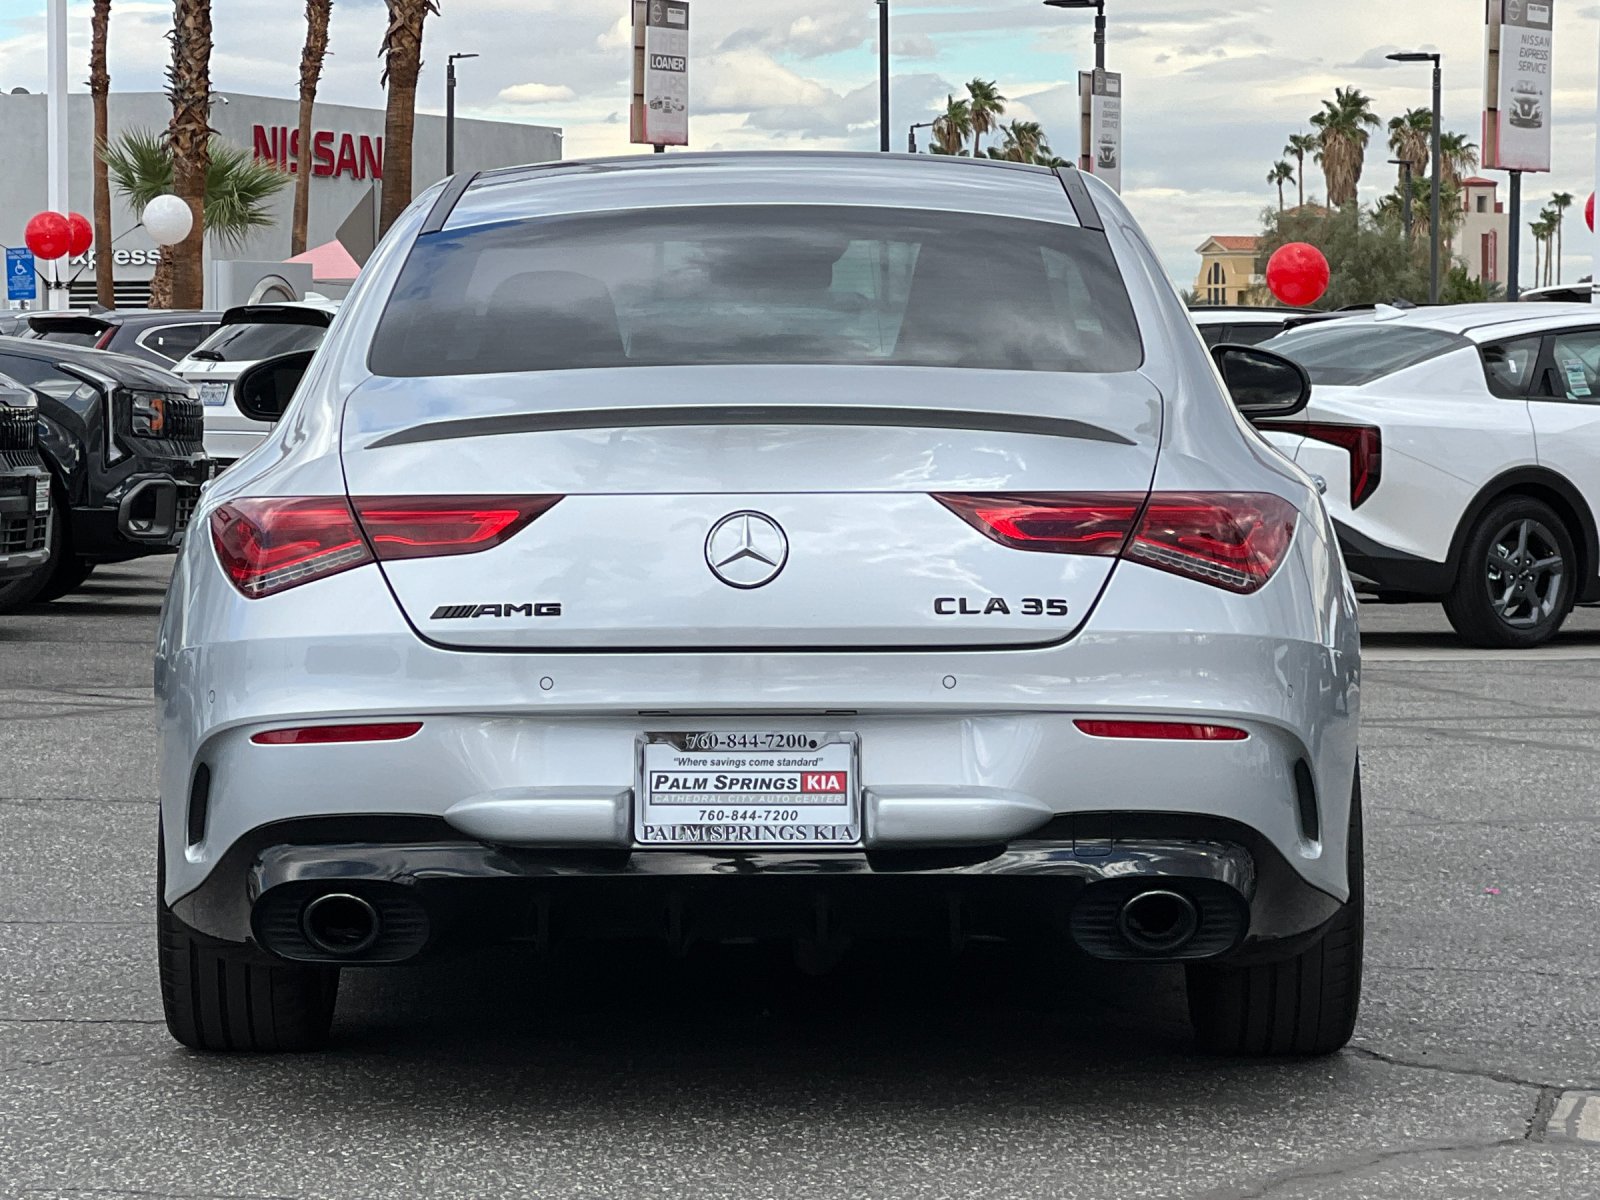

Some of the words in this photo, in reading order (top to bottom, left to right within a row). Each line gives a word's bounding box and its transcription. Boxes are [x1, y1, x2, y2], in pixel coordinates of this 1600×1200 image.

[1521, 34, 1551, 47] NISSAN
[1519, 47, 1549, 60] EXPRESS
[651, 55, 685, 71] LOANER
[1518, 60, 1547, 74] SERVICE
[253, 124, 383, 179] NISSAN
[471, 602, 562, 617] AMG
[933, 597, 1011, 615] CLA
[1020, 597, 1069, 616] 35
[685, 733, 808, 750] 760-844-7200
[710, 758, 747, 768] savings
[749, 759, 775, 768] come
[654, 774, 708, 790] PALM
[714, 774, 798, 790] SPRINGS
[807, 775, 841, 790] KIA
[654, 794, 723, 804] CATHEDRAL
[727, 794, 754, 804] CITY
[758, 794, 790, 804] AUTO
[795, 794, 842, 804] CENTER
[698, 809, 799, 822] 760-844-7200
[643, 825, 704, 841] PALM
[709, 825, 807, 841] SPRINGS
[814, 825, 854, 841] KIA
